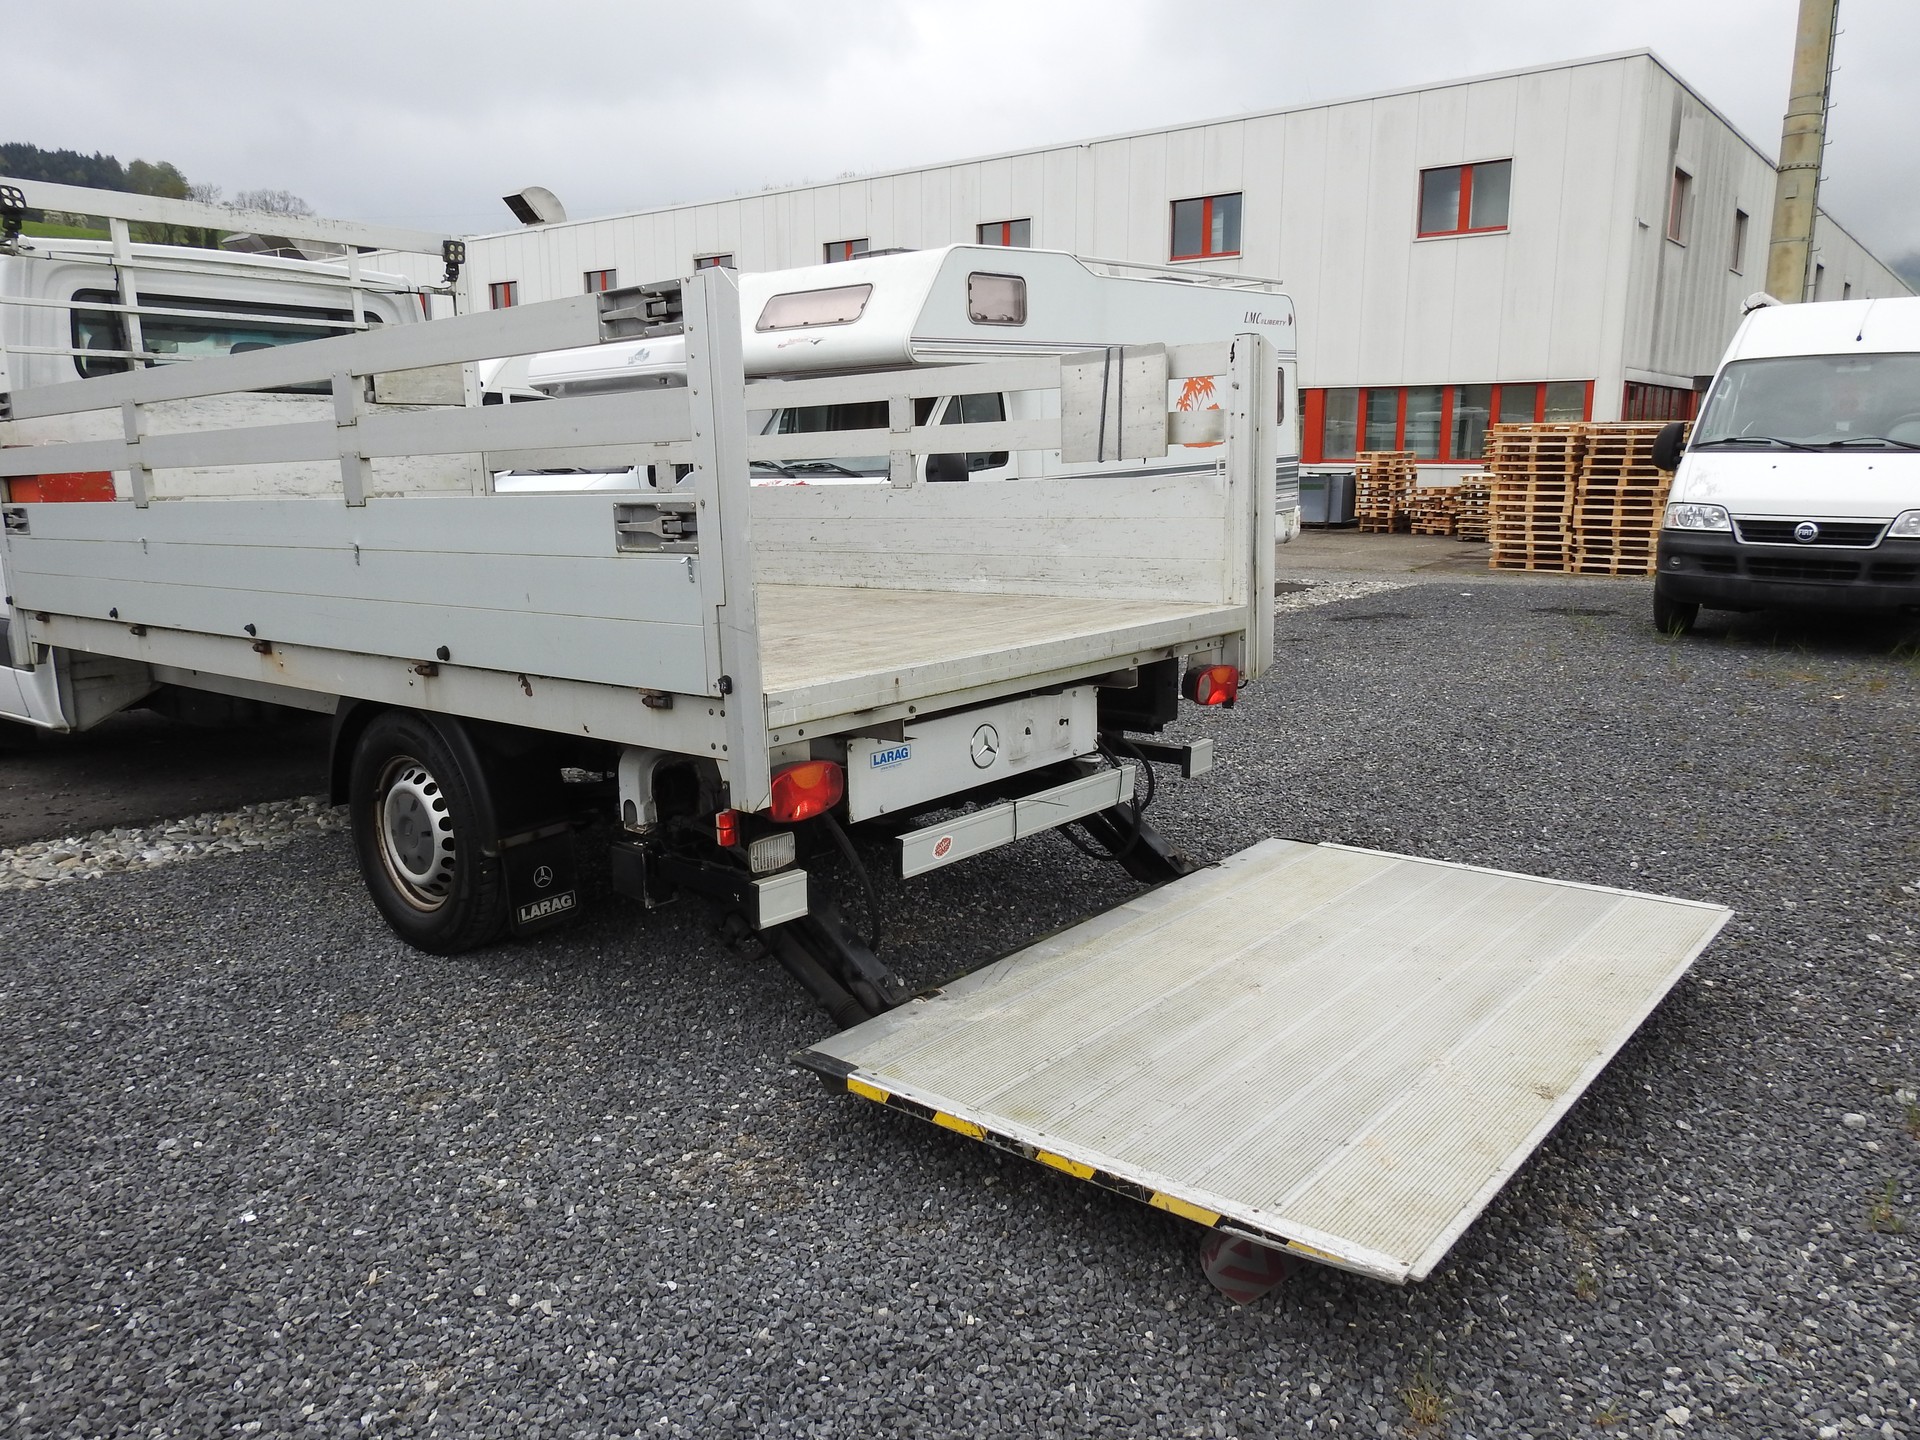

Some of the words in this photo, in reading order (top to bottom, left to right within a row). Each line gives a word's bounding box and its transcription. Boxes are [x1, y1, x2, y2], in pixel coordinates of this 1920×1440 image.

[1243, 311, 1262, 324] LMC
[873, 747, 909, 766] LARAG
[521, 895, 572, 921] LARAG
